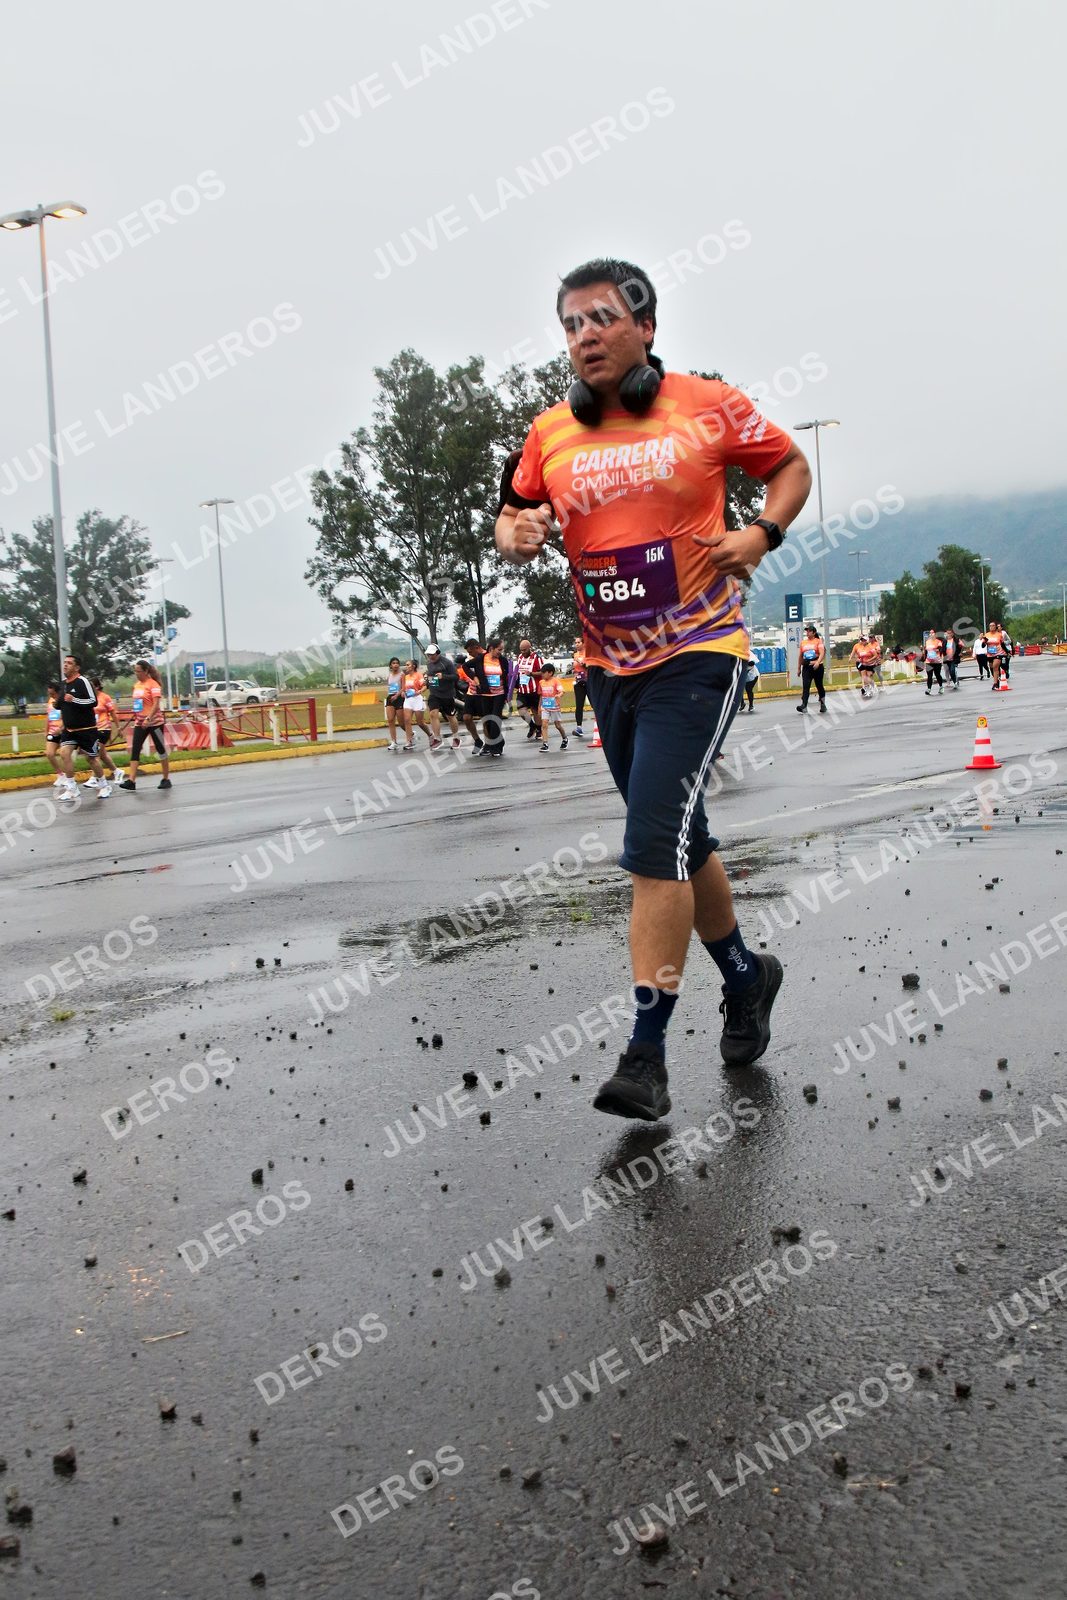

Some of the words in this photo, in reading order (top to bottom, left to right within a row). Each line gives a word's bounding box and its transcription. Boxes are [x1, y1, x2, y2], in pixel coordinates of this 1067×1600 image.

[571, 436, 675, 474] CARRERA
[599, 578, 646, 602] 684
[788, 605, 798, 619] E
